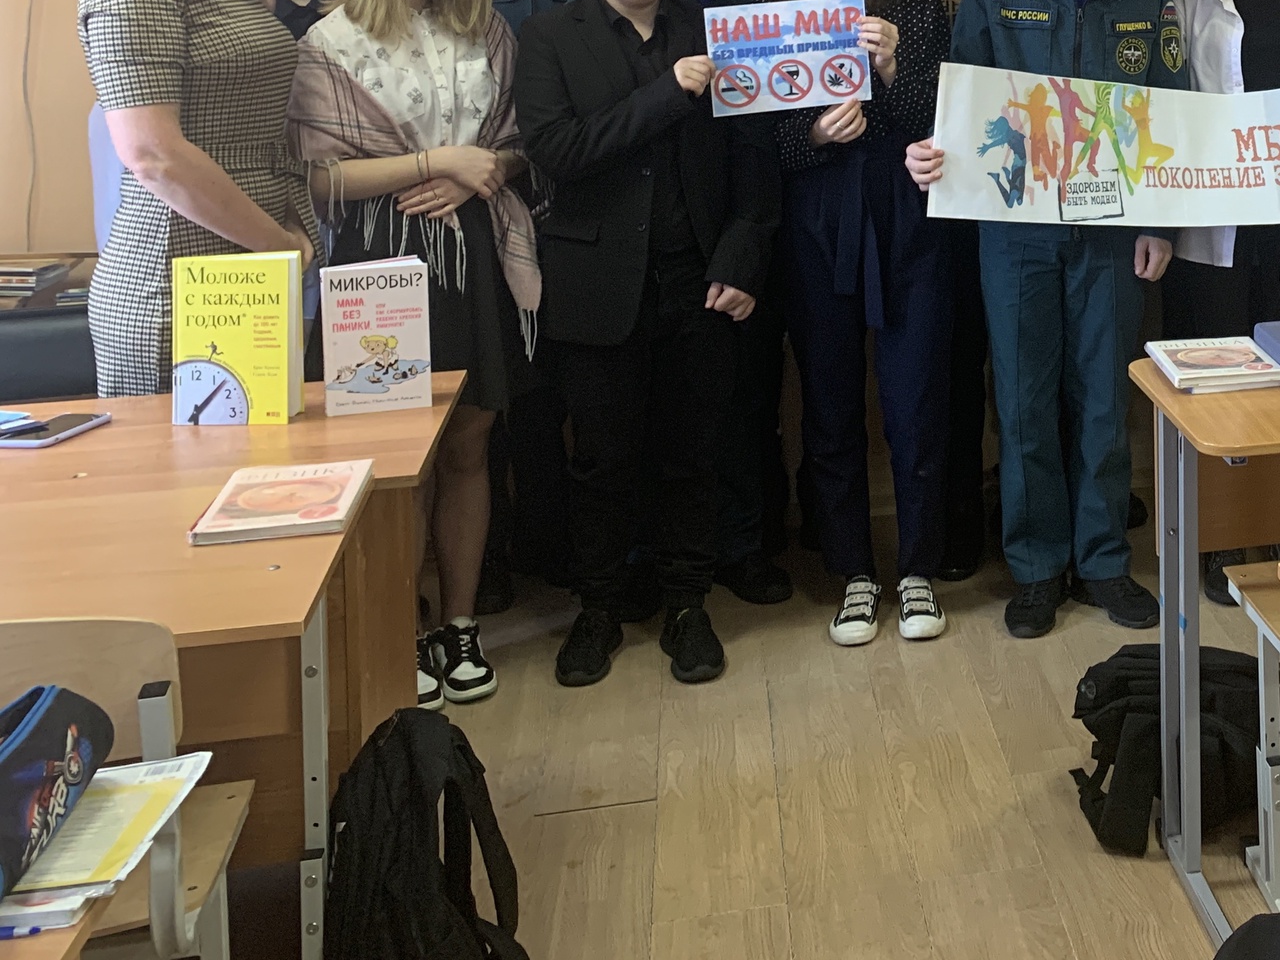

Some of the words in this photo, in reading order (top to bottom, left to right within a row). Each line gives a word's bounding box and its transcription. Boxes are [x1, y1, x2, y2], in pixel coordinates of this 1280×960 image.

[1001, 8, 1017, 19] МЧС
[1018, 11, 1049, 21] РОССИИ
[709, 13, 781, 43] НАШ
[794, 6, 862, 36] МИР
[712, 49, 734, 61] БЕЗ
[736, 43, 795, 59] ВРЕДНЫХ
[1143, 165, 1265, 189] ПОКОЛЕНИЕ
[1066, 181, 1116, 195] ЗДОРОВЫМ
[1067, 196, 1088, 206] БЫТЬ
[186, 267, 266, 284] Моложе
[329, 272, 423, 293] МИКРОБЫ?
[185, 293, 195, 306] с
[202, 293, 280, 308] каждым
[342, 310, 361, 320] БЕЗ
[191, 370, 202, 381] 12
[225, 389, 232, 399] 2
[229, 407, 237, 418] 3
